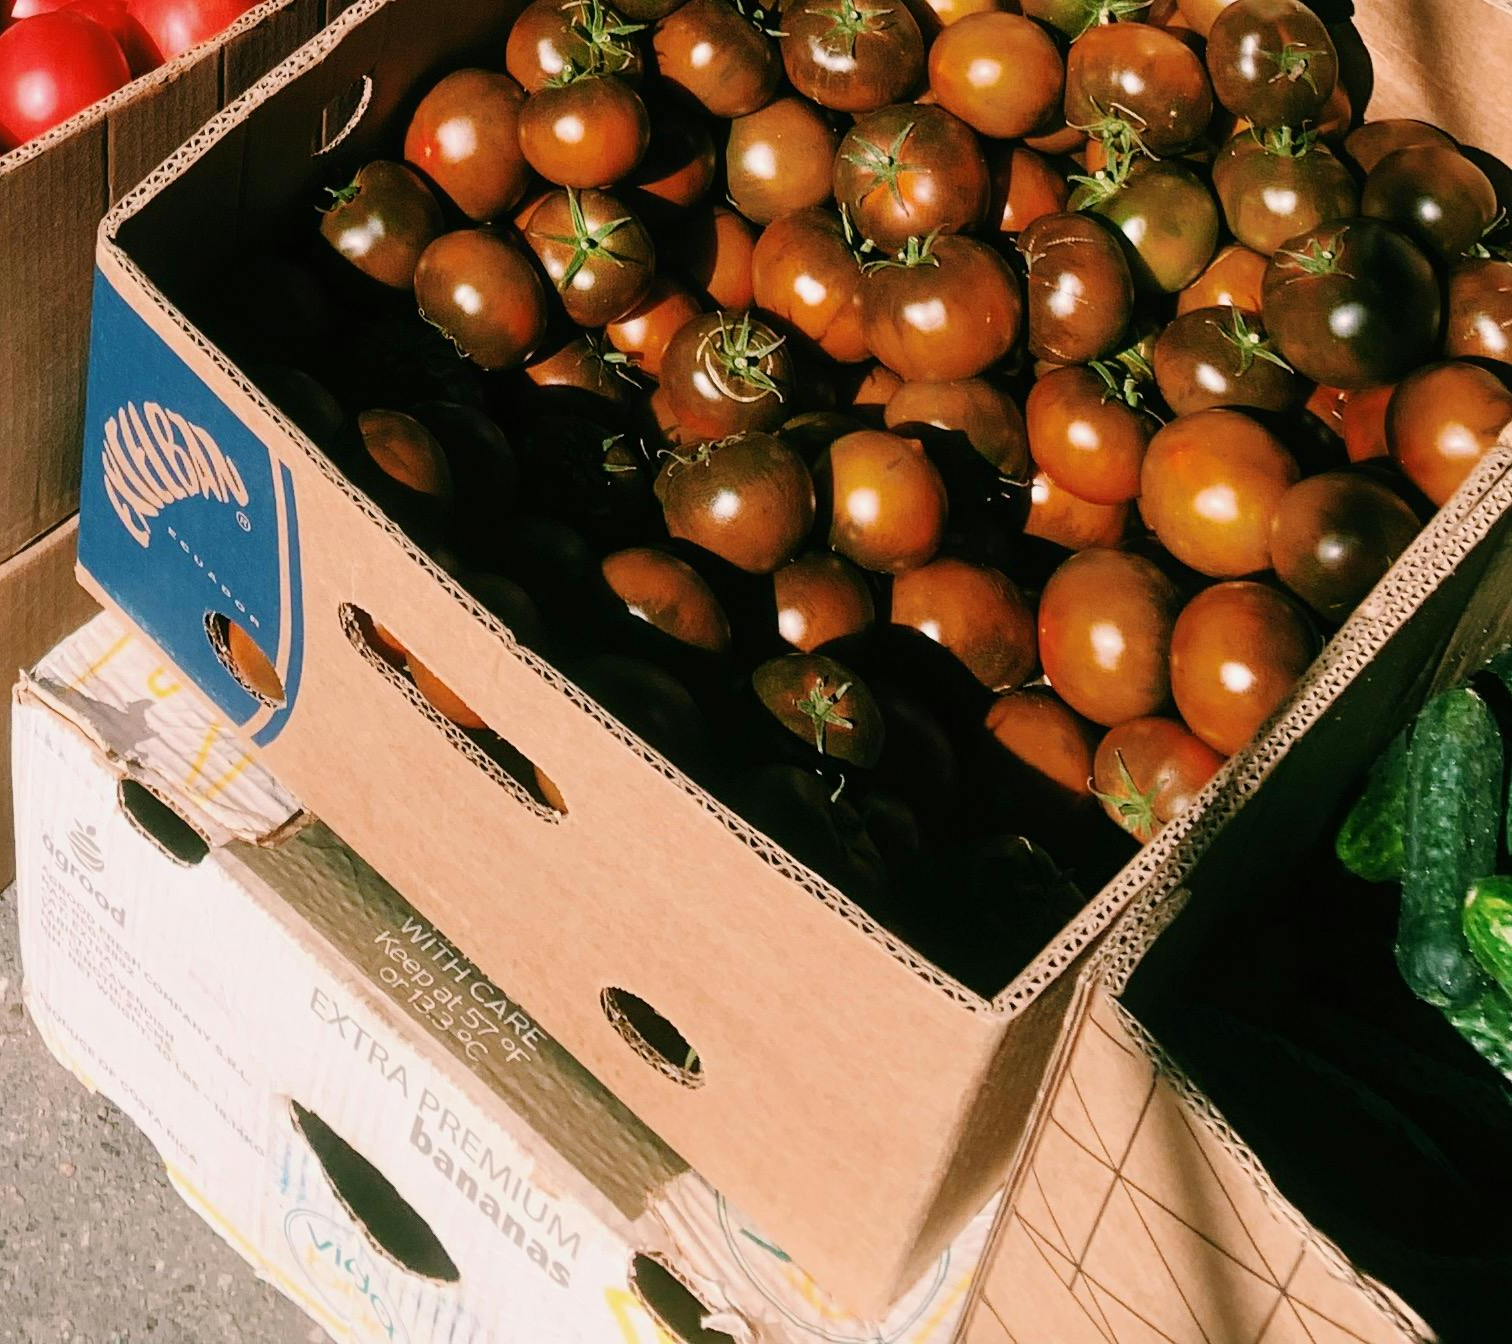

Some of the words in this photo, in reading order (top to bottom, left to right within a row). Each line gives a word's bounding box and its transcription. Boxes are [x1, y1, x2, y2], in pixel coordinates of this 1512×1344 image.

[168, 526, 261, 629] ECUADOR
[42, 833, 126, 929] agrood
[373, 930, 435, 988] Keep
[433, 983, 466, 1012] at
[459, 1007, 500, 1040] 57
[378, 966, 410, 994] or
[406, 988, 454, 1032] 13.3
[399, 915, 472, 984] WITH
[469, 979, 548, 1052] CARE
[309, 986, 410, 1099] EXTRA
[417, 1087, 583, 1261] PREMIUM
[409, 1113, 572, 1289] bananas
